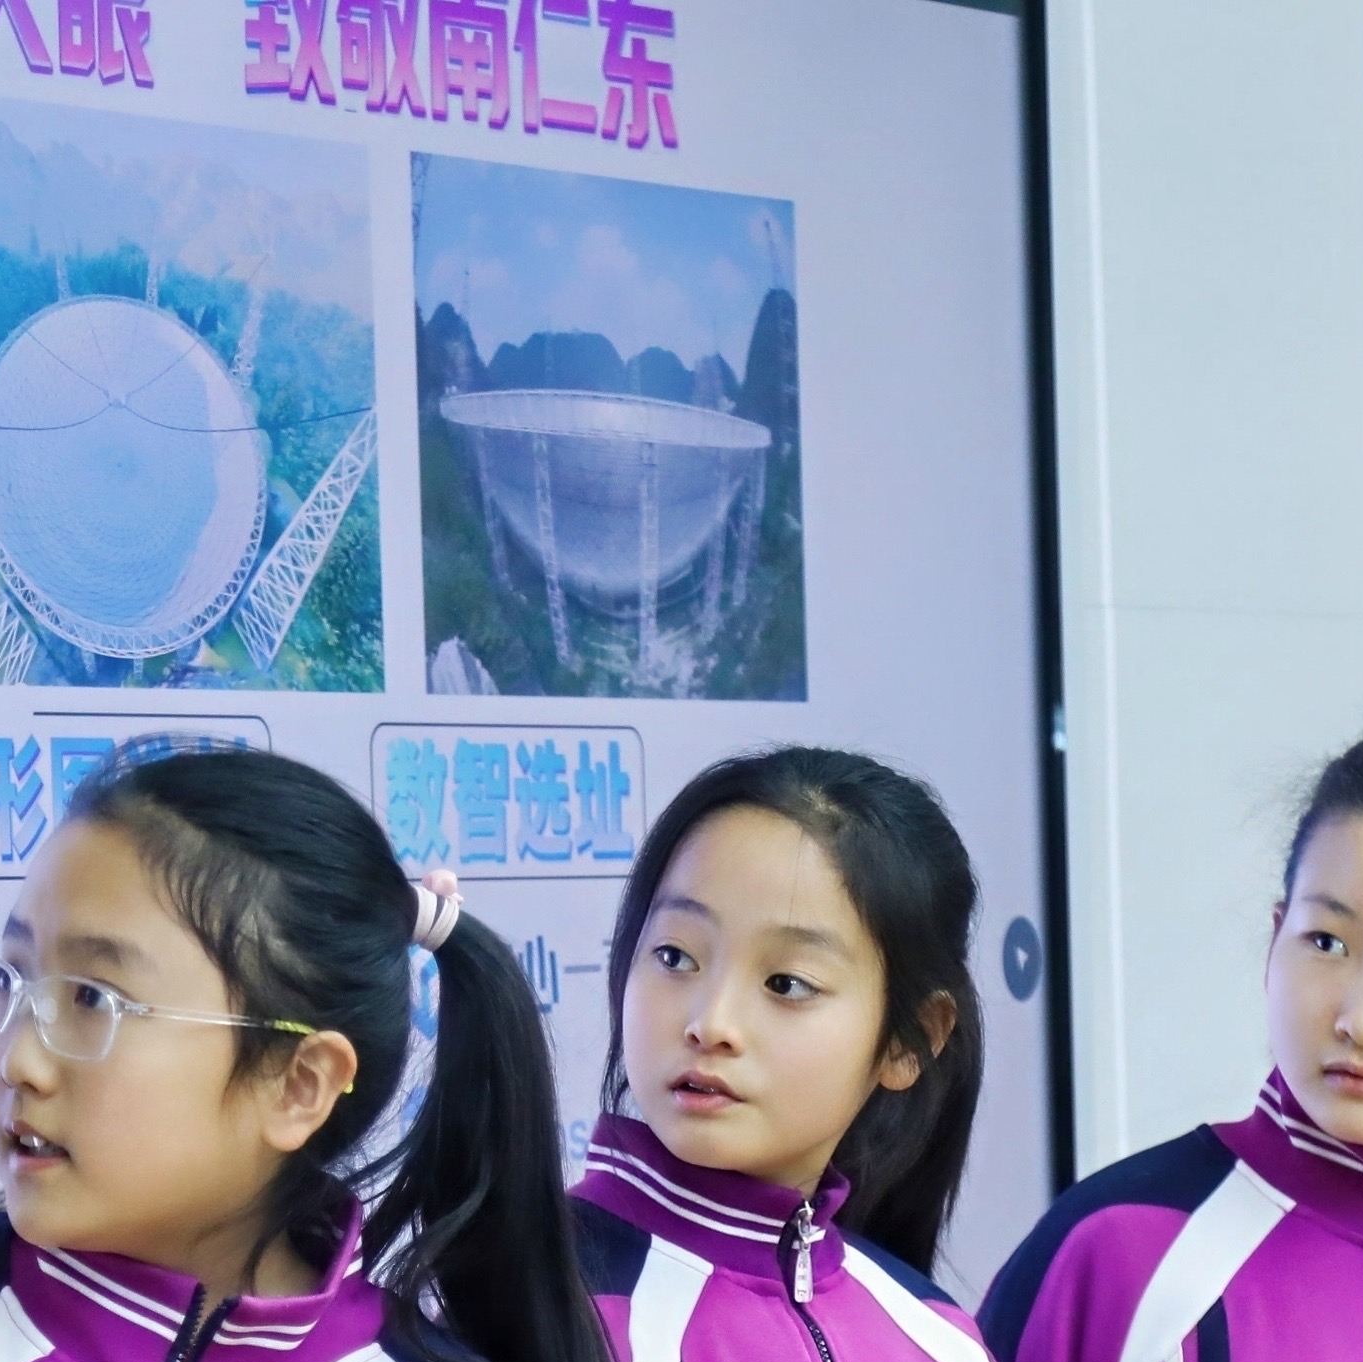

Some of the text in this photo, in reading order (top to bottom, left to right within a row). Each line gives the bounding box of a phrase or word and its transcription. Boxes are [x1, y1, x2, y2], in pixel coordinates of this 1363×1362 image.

[245, 0, 678, 149] 致敬南仁东
[387, 737, 634, 864] 数智选址
